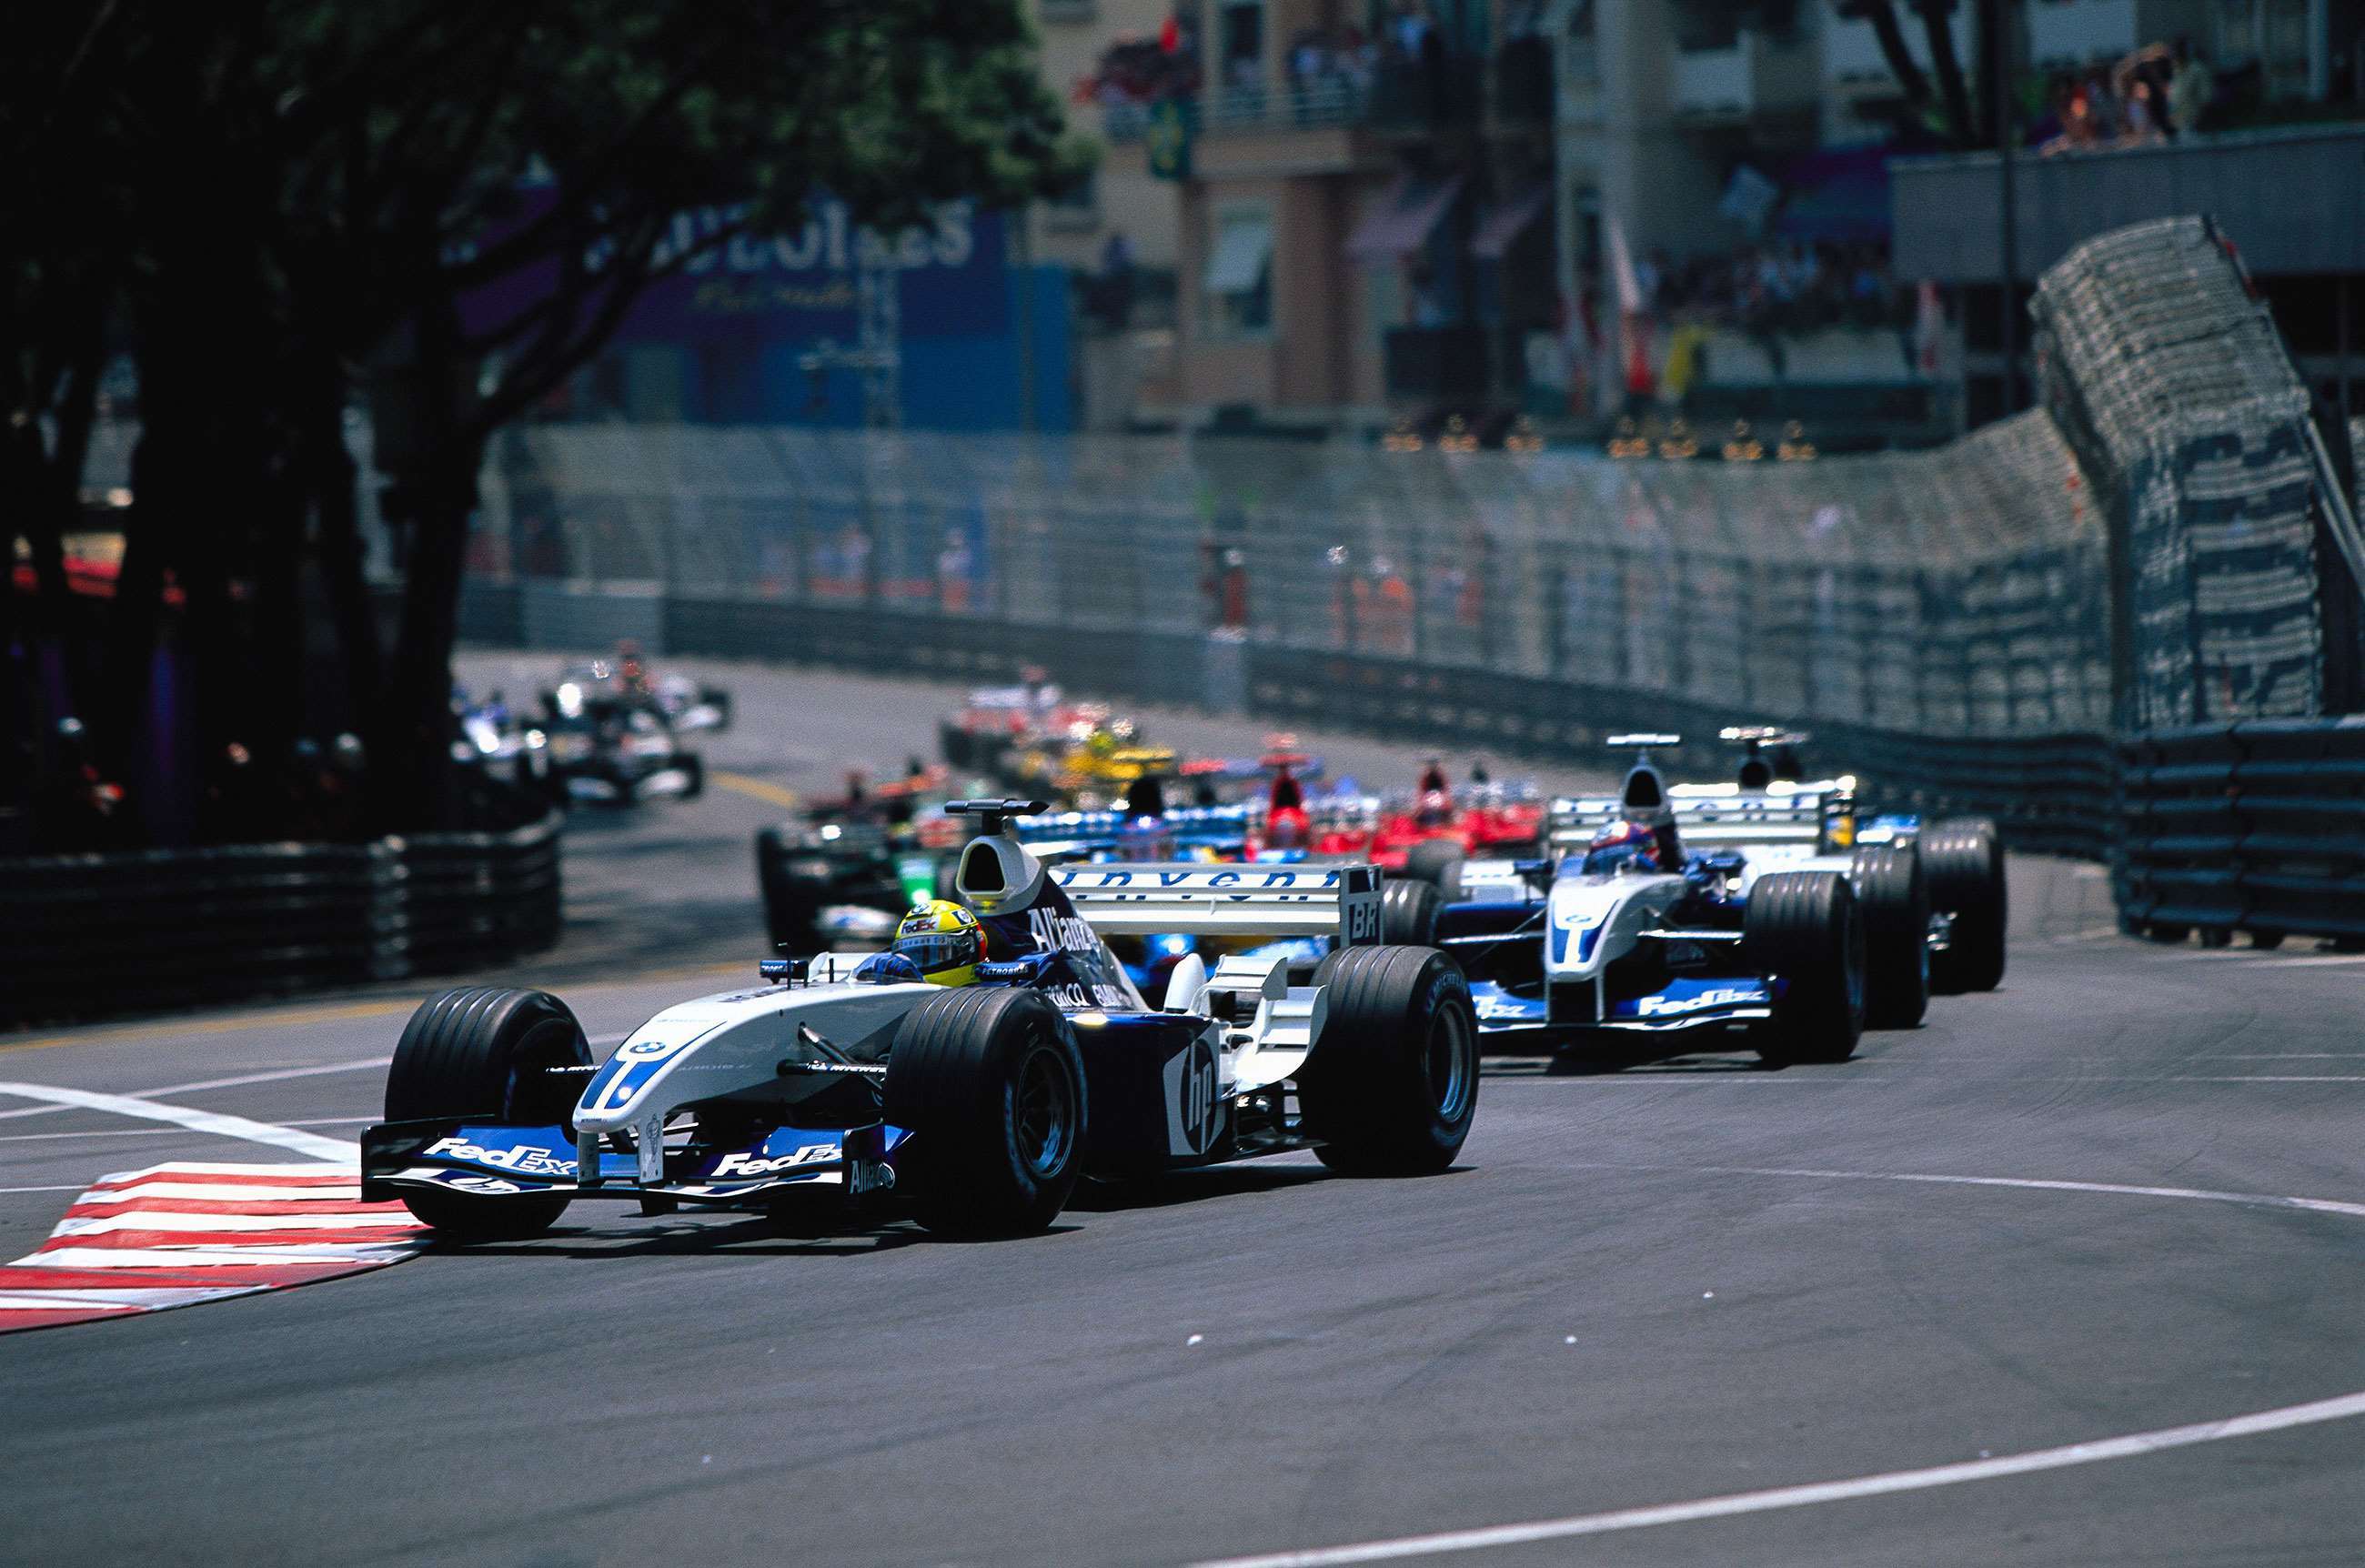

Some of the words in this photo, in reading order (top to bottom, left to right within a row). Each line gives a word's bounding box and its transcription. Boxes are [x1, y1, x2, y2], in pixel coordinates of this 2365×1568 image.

[1352, 901, 1377, 940] BR
[1187, 1040, 1213, 1155] hp
[423, 1137, 579, 1176] FedEx
[710, 1143, 843, 1178] FedEx
